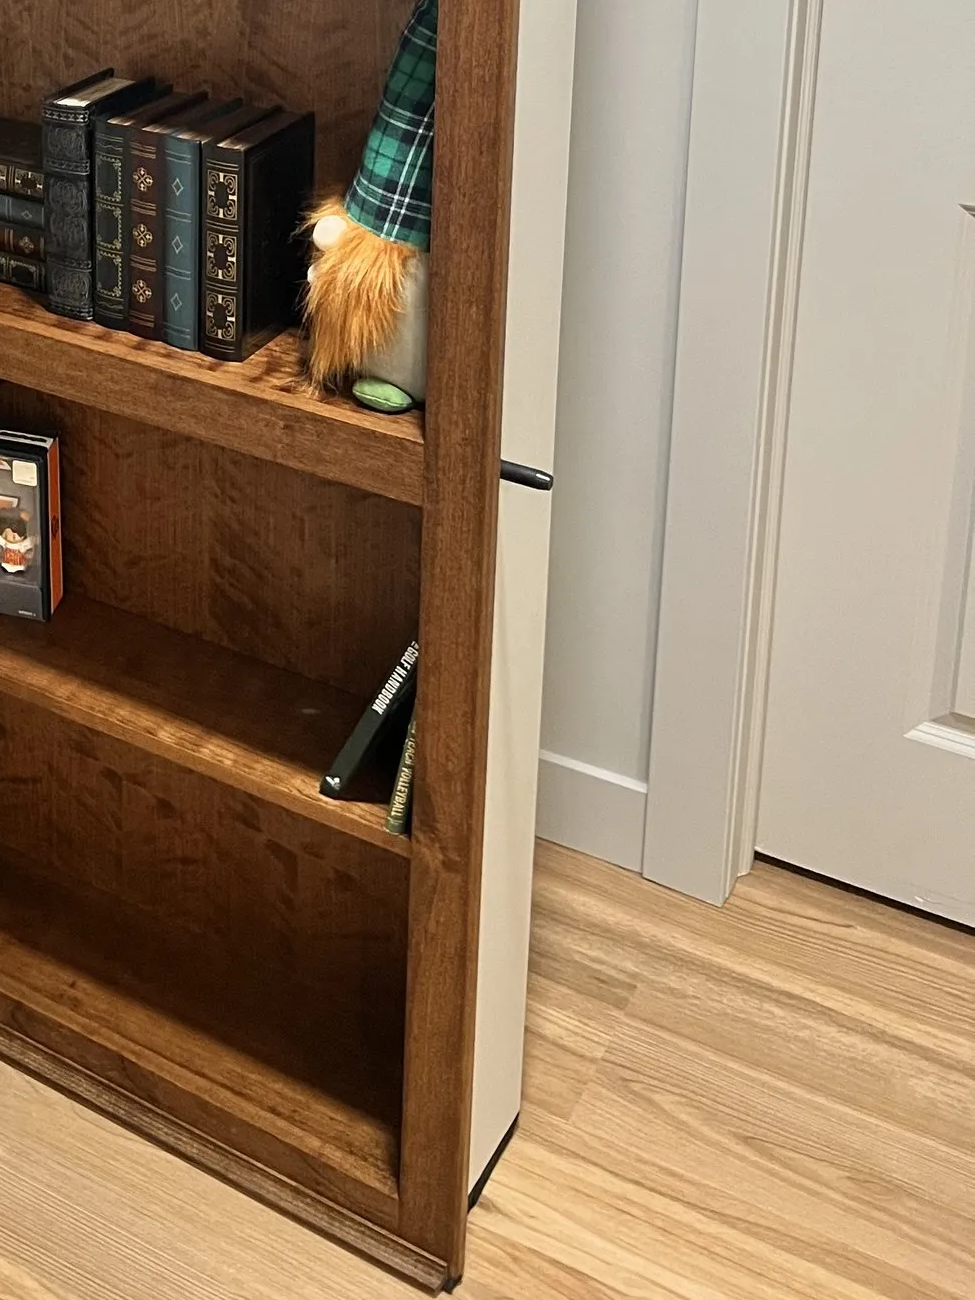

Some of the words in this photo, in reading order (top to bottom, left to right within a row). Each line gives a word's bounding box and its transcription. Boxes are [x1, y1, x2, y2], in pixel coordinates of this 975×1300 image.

[400, 646, 419, 670] GOLF
[371, 665, 408, 715] HANDBOOK
[390, 767, 413, 817] VOLLEYBALL
